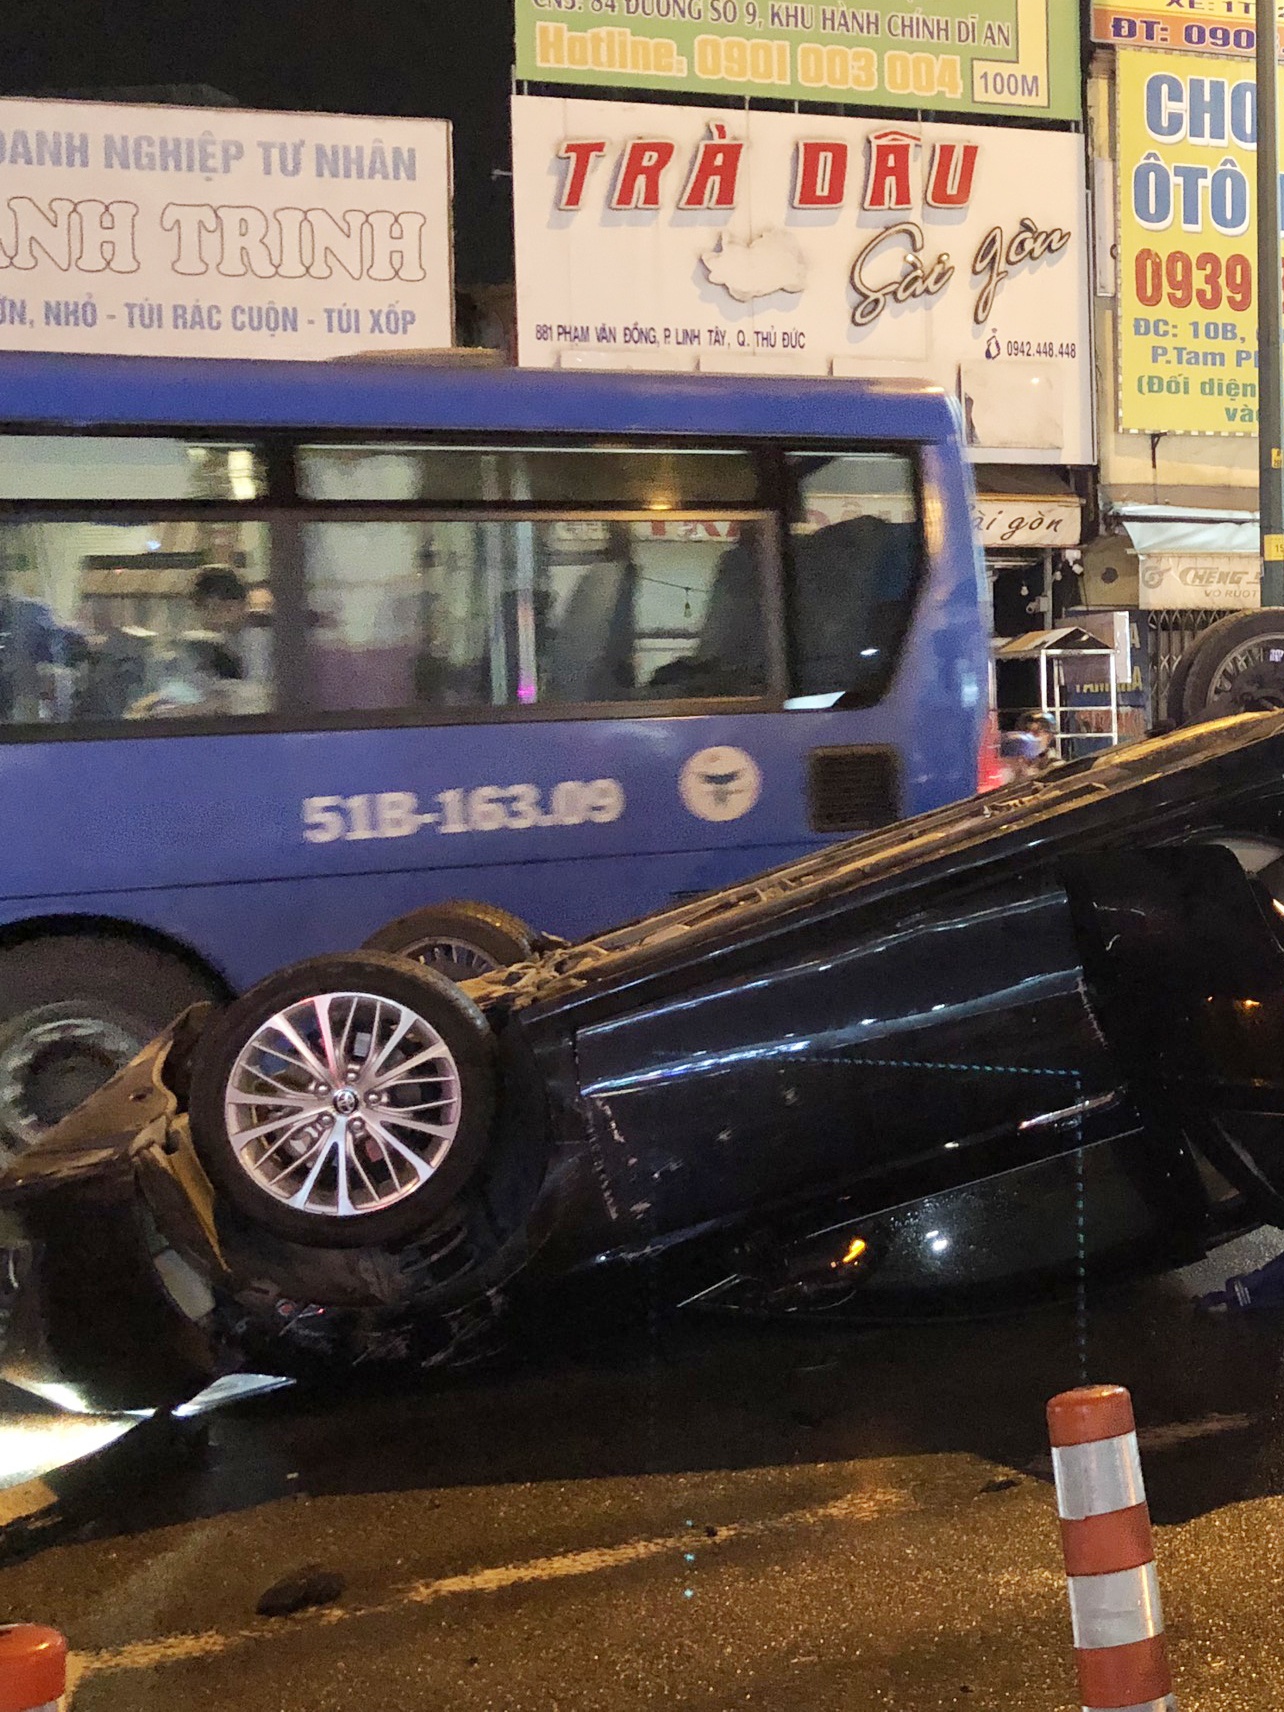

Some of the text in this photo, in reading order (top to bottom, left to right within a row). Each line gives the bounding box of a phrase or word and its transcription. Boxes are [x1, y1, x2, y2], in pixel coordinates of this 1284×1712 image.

[770, 4, 813, 29] KHU
[821, 0, 880, 36] HÀNH
[887, 8, 950, 41] CHÍNH
[983, 23, 1011, 47] AN
[1112, 17, 1169, 43] ĐT:
[695, 35, 791, 84] 0901
[798, 43, 878, 90] 003
[884, 51, 963, 98] 004
[979, 71, 1040, 97] 100M
[1145, 74, 1257, 144] CHO
[0, 129, 417, 182] ANH NGHIỆP TƯ NHÂN
[559, 123, 745, 209] TRÀ
[1133, 151, 1248, 229] ÔTÔ
[161, 202, 427, 282] TRINH
[850, 217, 1071, 326] Sài gòn
[1134, 248, 1252, 312] 0939
[44, 292, 98, 328] NHỎ
[124, 297, 163, 328] TÚI
[172, 299, 222, 331] RÁC
[231, 300, 299, 337] CUỘN
[324, 303, 361, 334] TÚI
[369, 300, 416, 335] XỐP
[535, 324, 553, 342] 881
[557, 325, 590, 346] PHẠM
[623, 321, 660, 348] ĐỒNG,
[675, 328, 701, 346] LINH
[736, 329, 750, 347] Q.
[754, 325, 776, 349] THỦ
[781, 328, 806, 350] ĐỨC
[1133, 318, 1178, 338] ĐC:
[1188, 321, 1246, 344] 10B,
[1006, 340, 1078, 359] 0942.448.448
[1151, 345, 1226, 368] P.Tam
[1137, 373, 1190, 395] (Đối
[1200, 377, 1256, 401] diện
[1224, 404, 1259, 423] và
[1007, 510, 1064, 541] gòn
[303, 778, 626, 843] 51B-163.09
